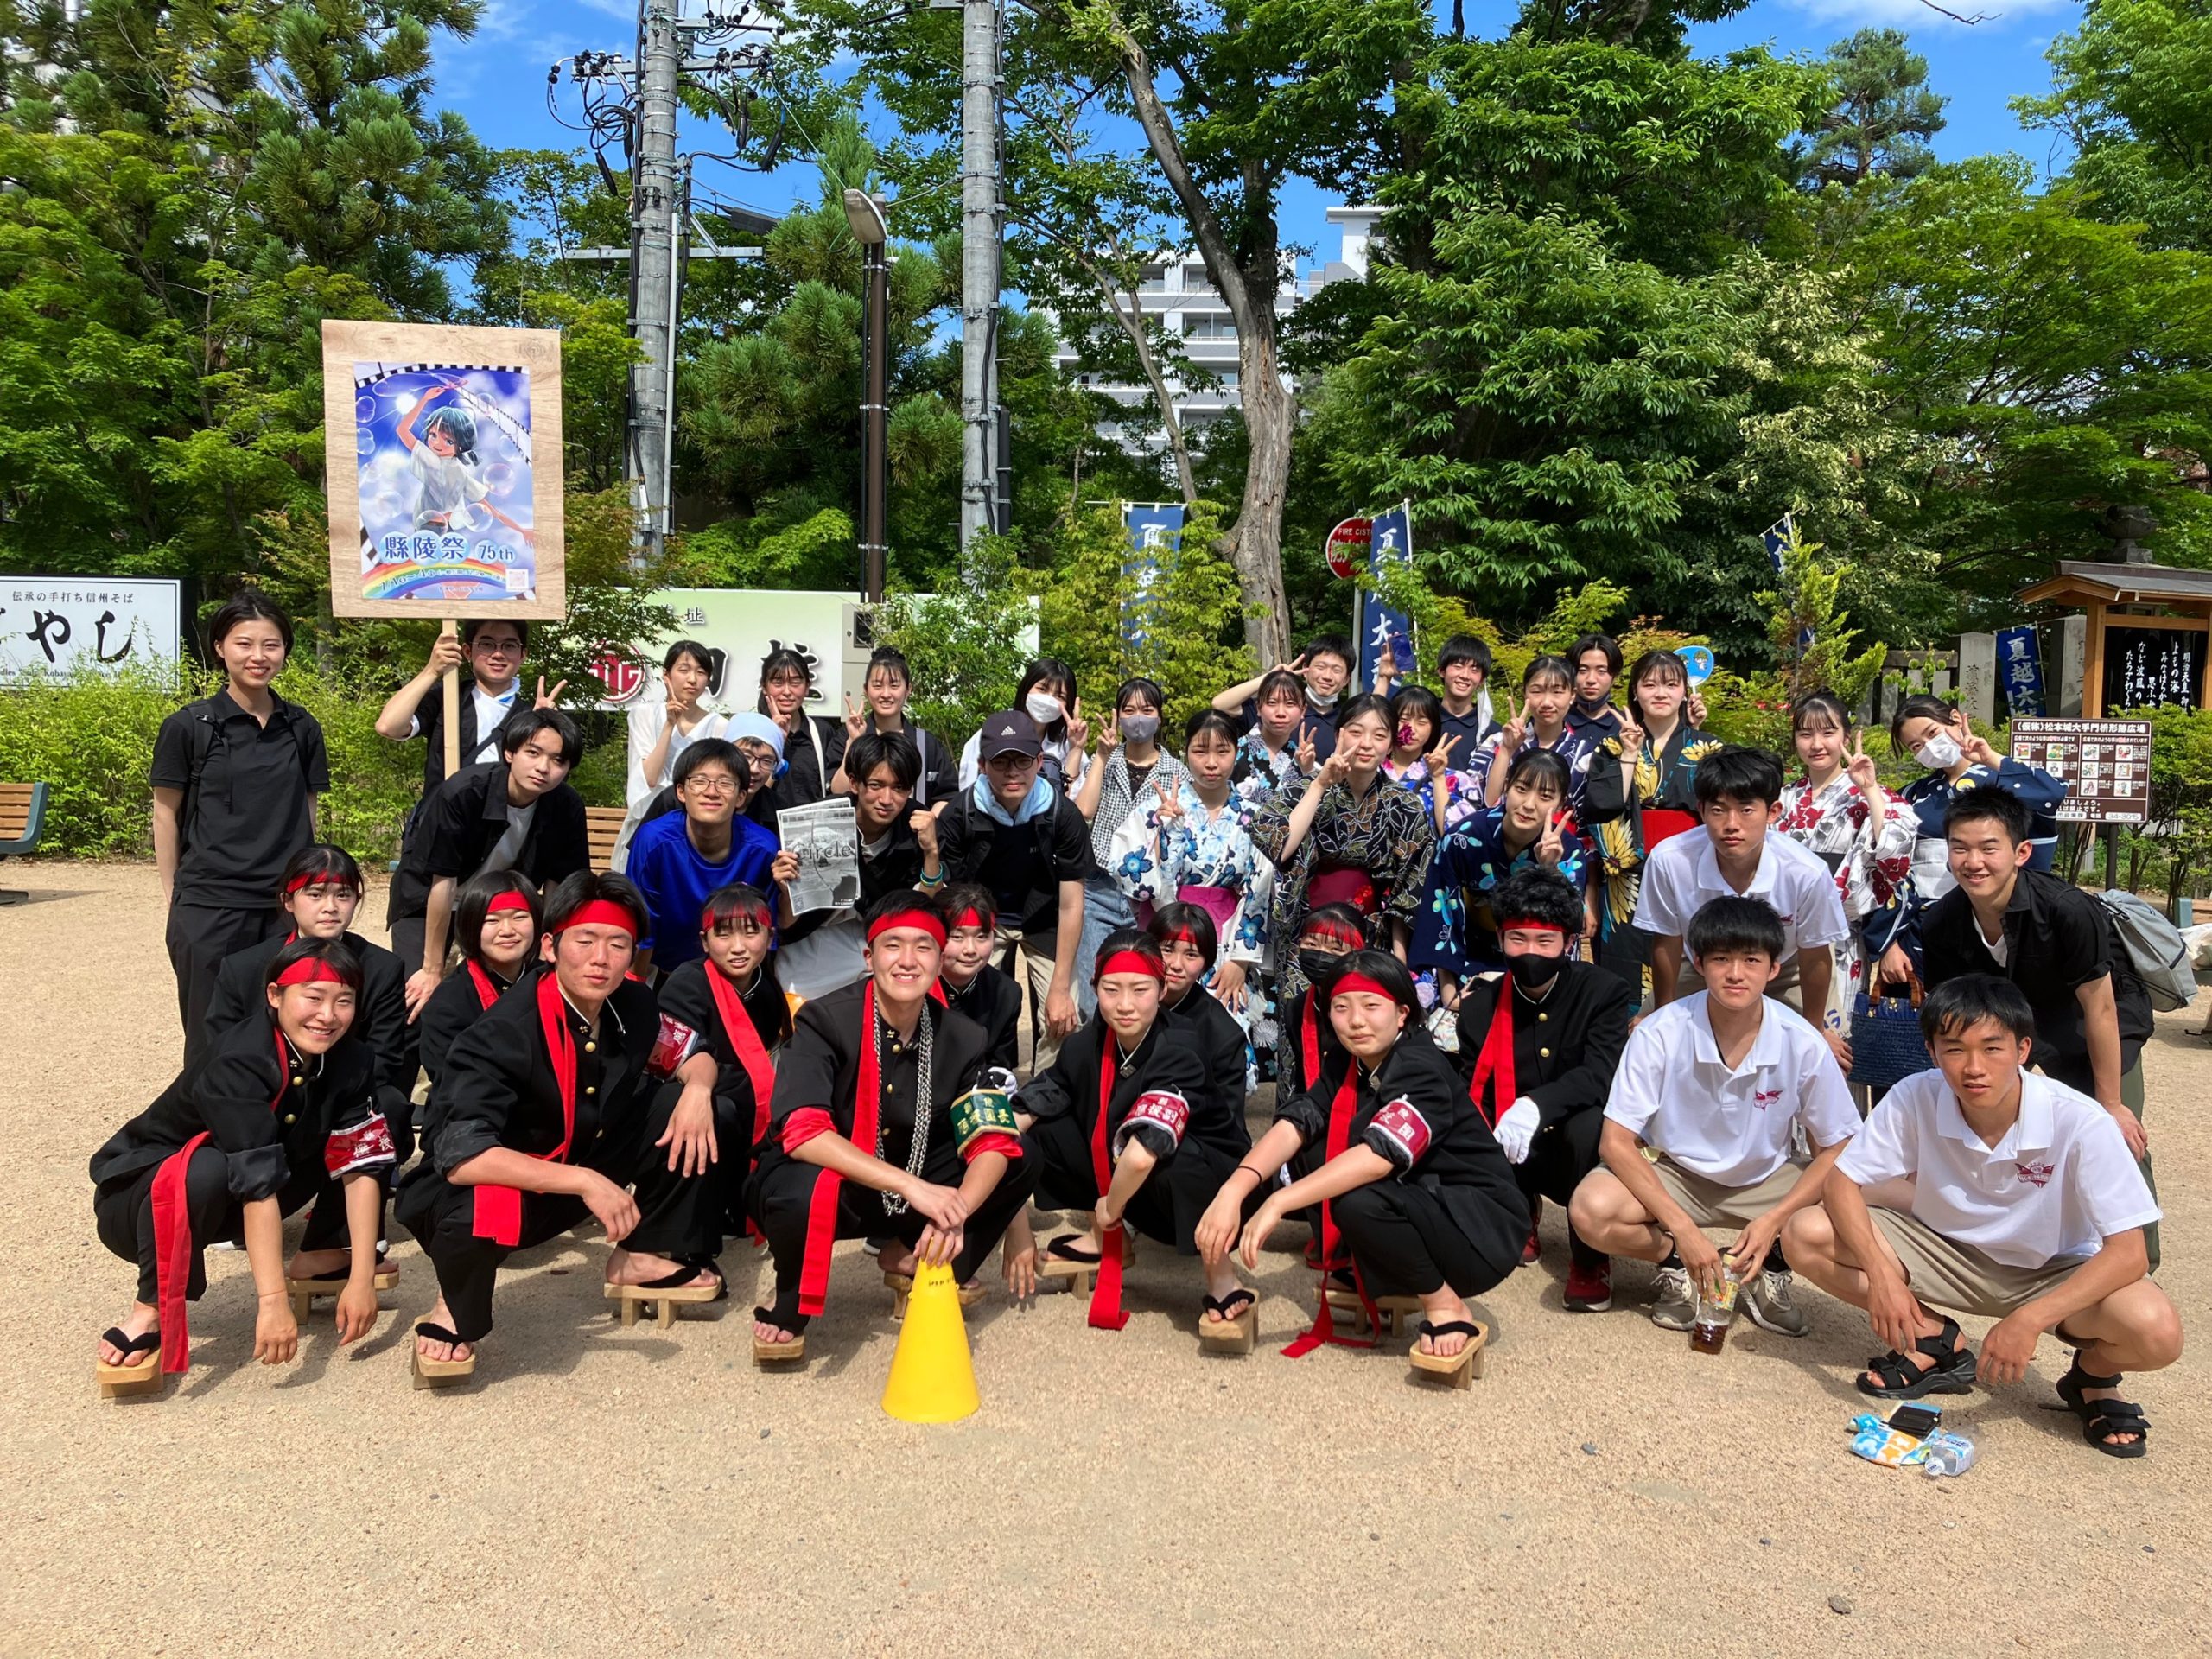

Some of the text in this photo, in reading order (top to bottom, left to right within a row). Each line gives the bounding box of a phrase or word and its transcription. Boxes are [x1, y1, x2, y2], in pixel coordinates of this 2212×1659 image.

[385, 537, 514, 561] 縣陵祭 75th
[12, 590, 134, 603] 伝承の手打ち信州そば
[0, 607, 132, 664] やし
[792, 841, 852, 861] Circle
